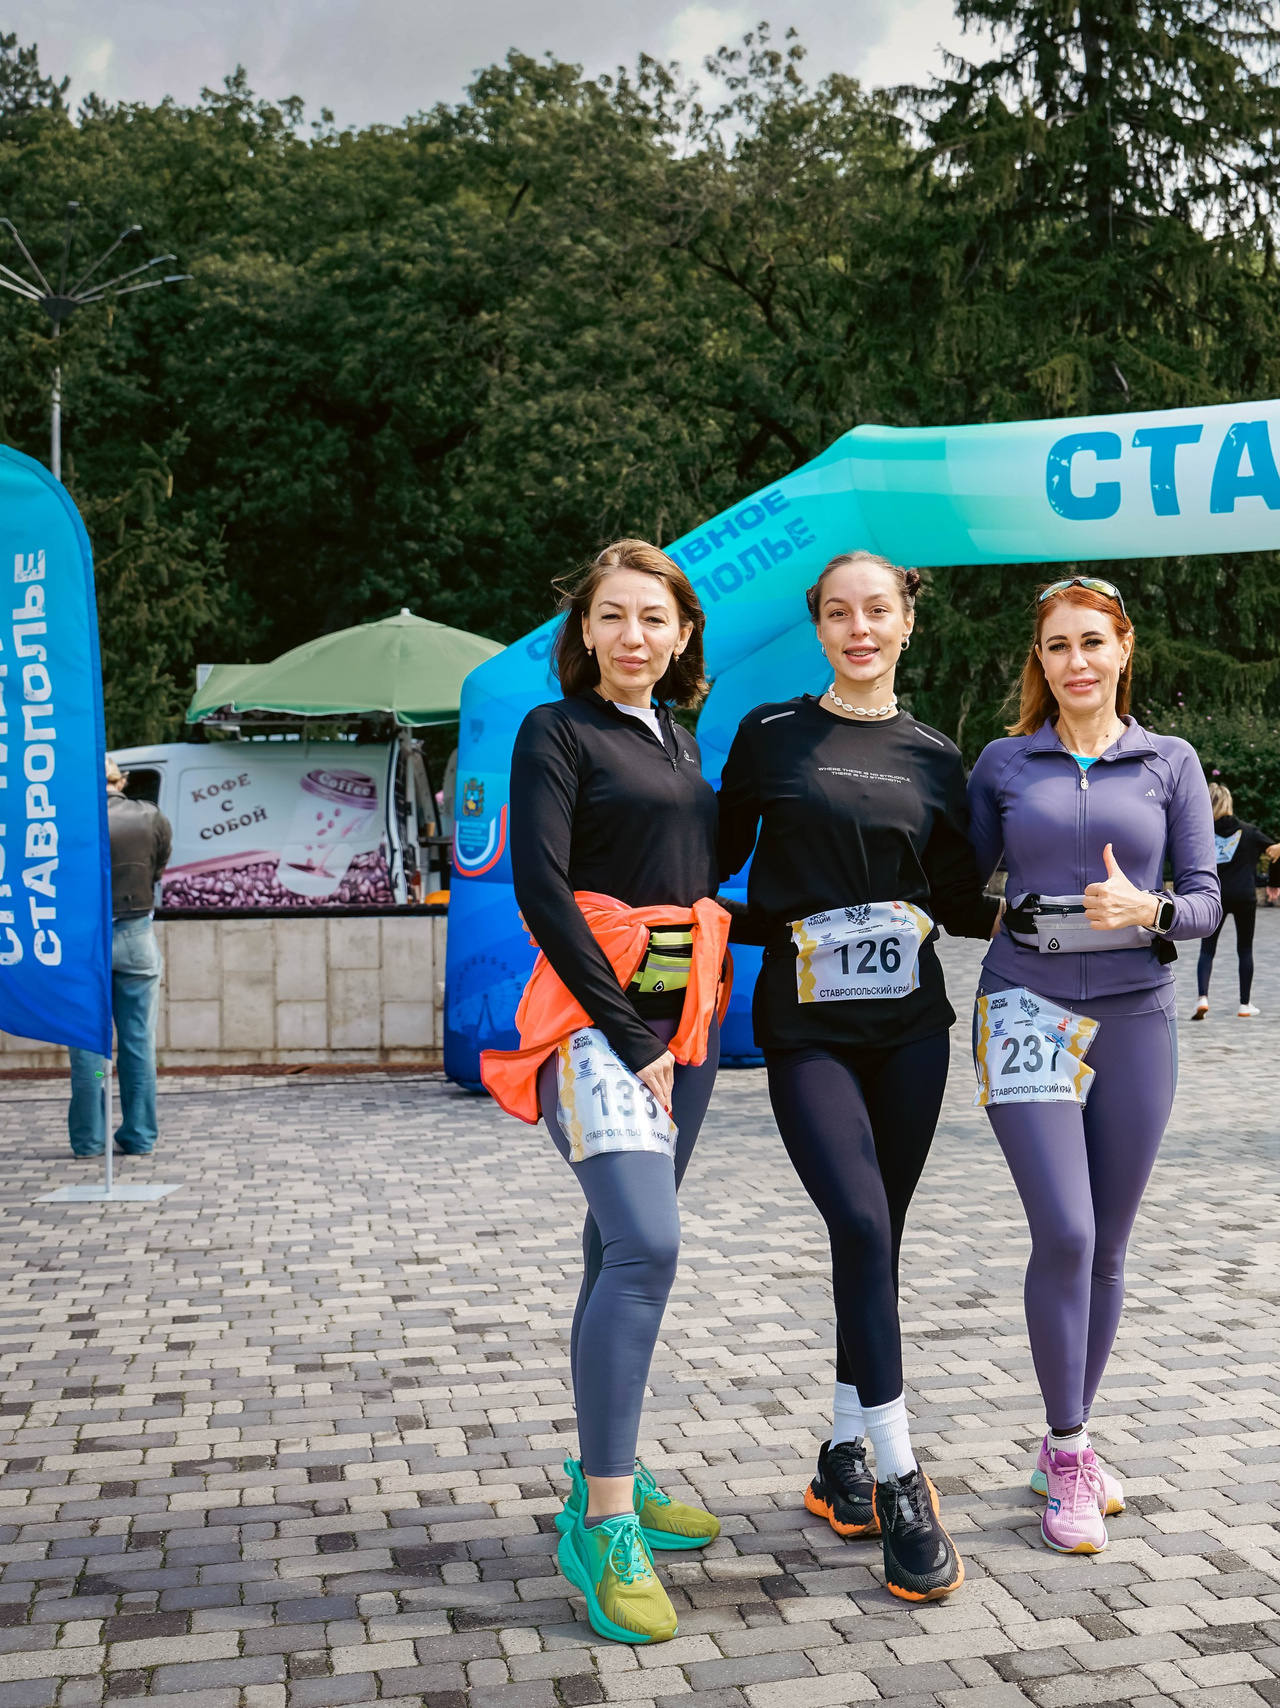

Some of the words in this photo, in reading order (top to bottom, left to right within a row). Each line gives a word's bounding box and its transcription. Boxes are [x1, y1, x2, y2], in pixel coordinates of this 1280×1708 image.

[13, 549, 62, 966] СТАВРОПОЛЬЕ
[191, 773, 251, 803] КОФЕ
[319, 773, 372, 797] Coffee
[221, 800, 234, 812] С
[200, 805, 268, 840] СОБОЙ
[808, 916, 831, 927] НАЦИИ
[833, 937, 901, 975] 126
[819, 984, 893, 998] СТАВРОПОЛЬСКИЙ
[893, 983, 910, 995] КРАЙ
[1001, 1034, 1060, 1076] 237
[592, 1079, 658, 1120] 133
[991, 1083, 1059, 1098] СТАВРОПОЛЬСКИЙ
